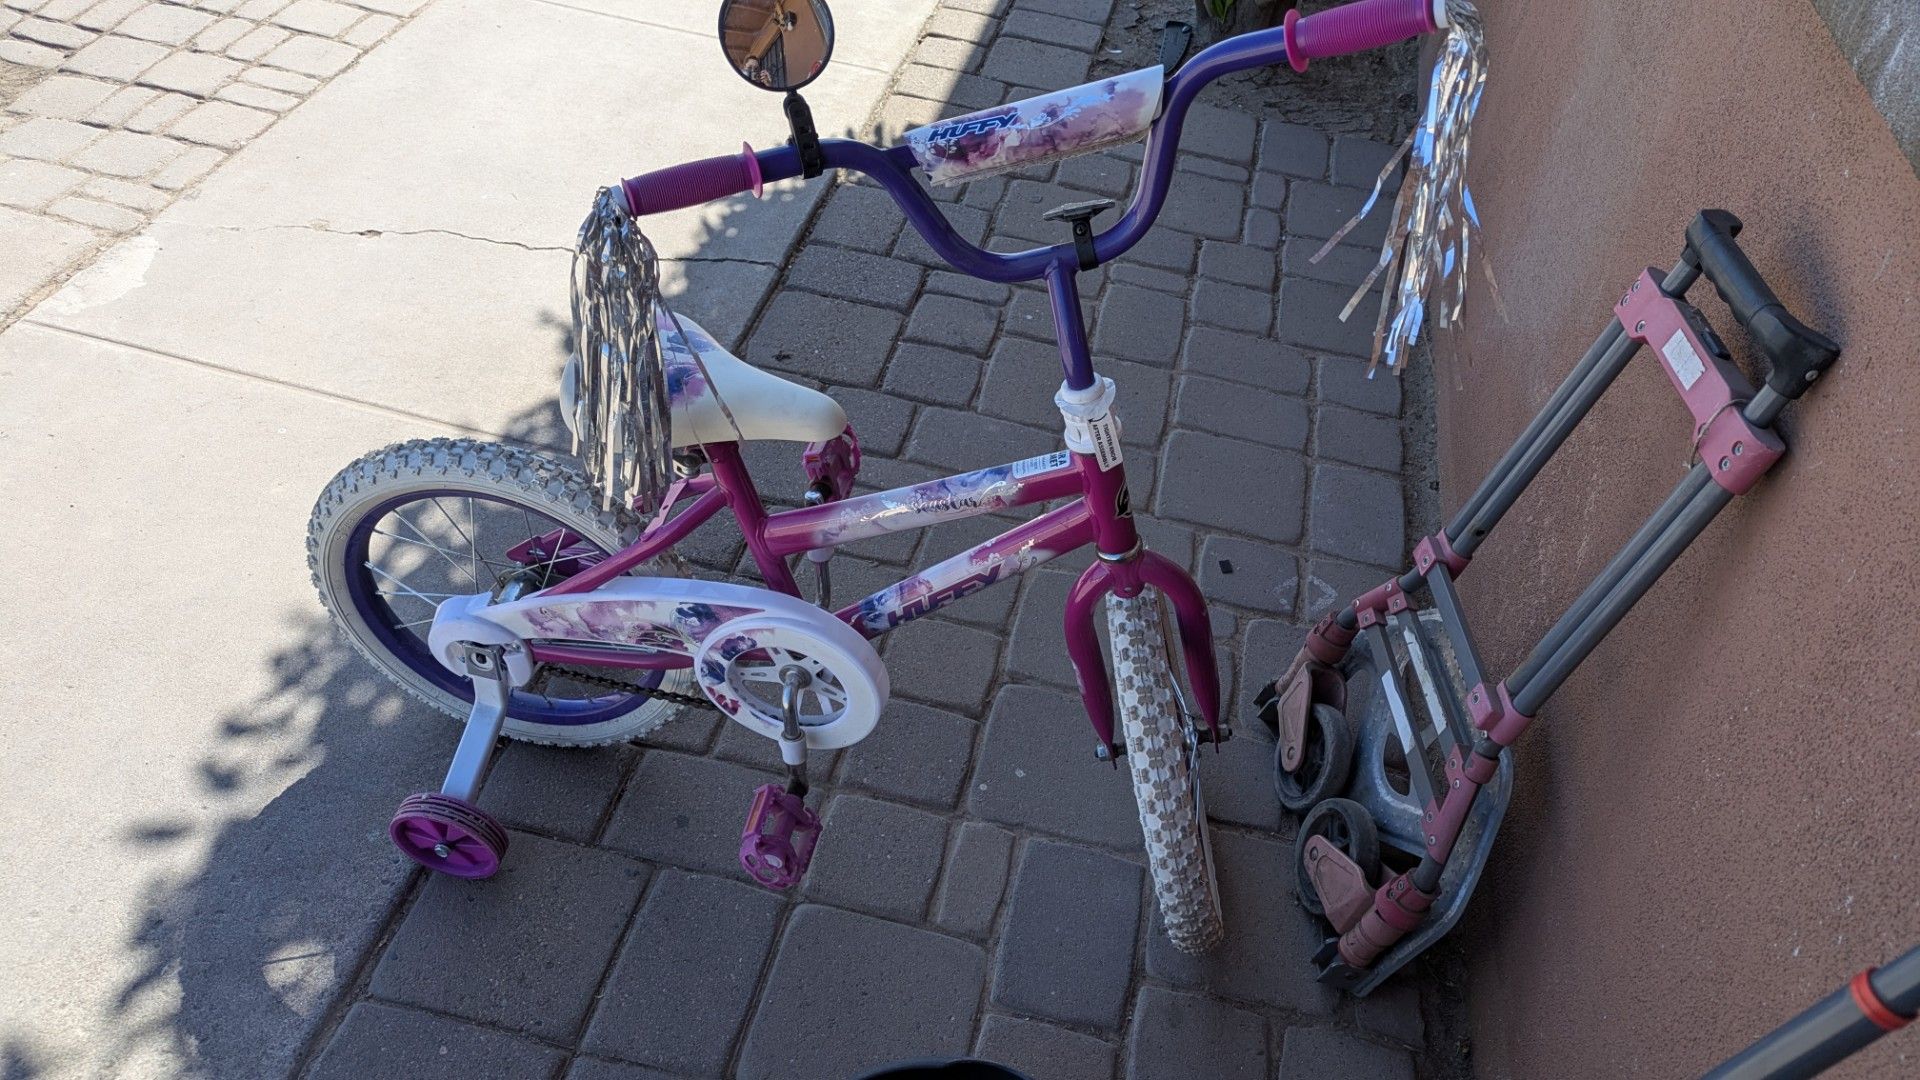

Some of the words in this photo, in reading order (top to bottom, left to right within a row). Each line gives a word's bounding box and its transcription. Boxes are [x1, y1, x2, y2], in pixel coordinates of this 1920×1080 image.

[927, 112, 1018, 143] HUFFY
[1093, 424, 1102, 442] AFTER
[1098, 441, 1110, 468] ASSEMBLY
[1103, 423, 1113, 446] TIGHTEN
[1109, 445, 1117, 462] KNOB
